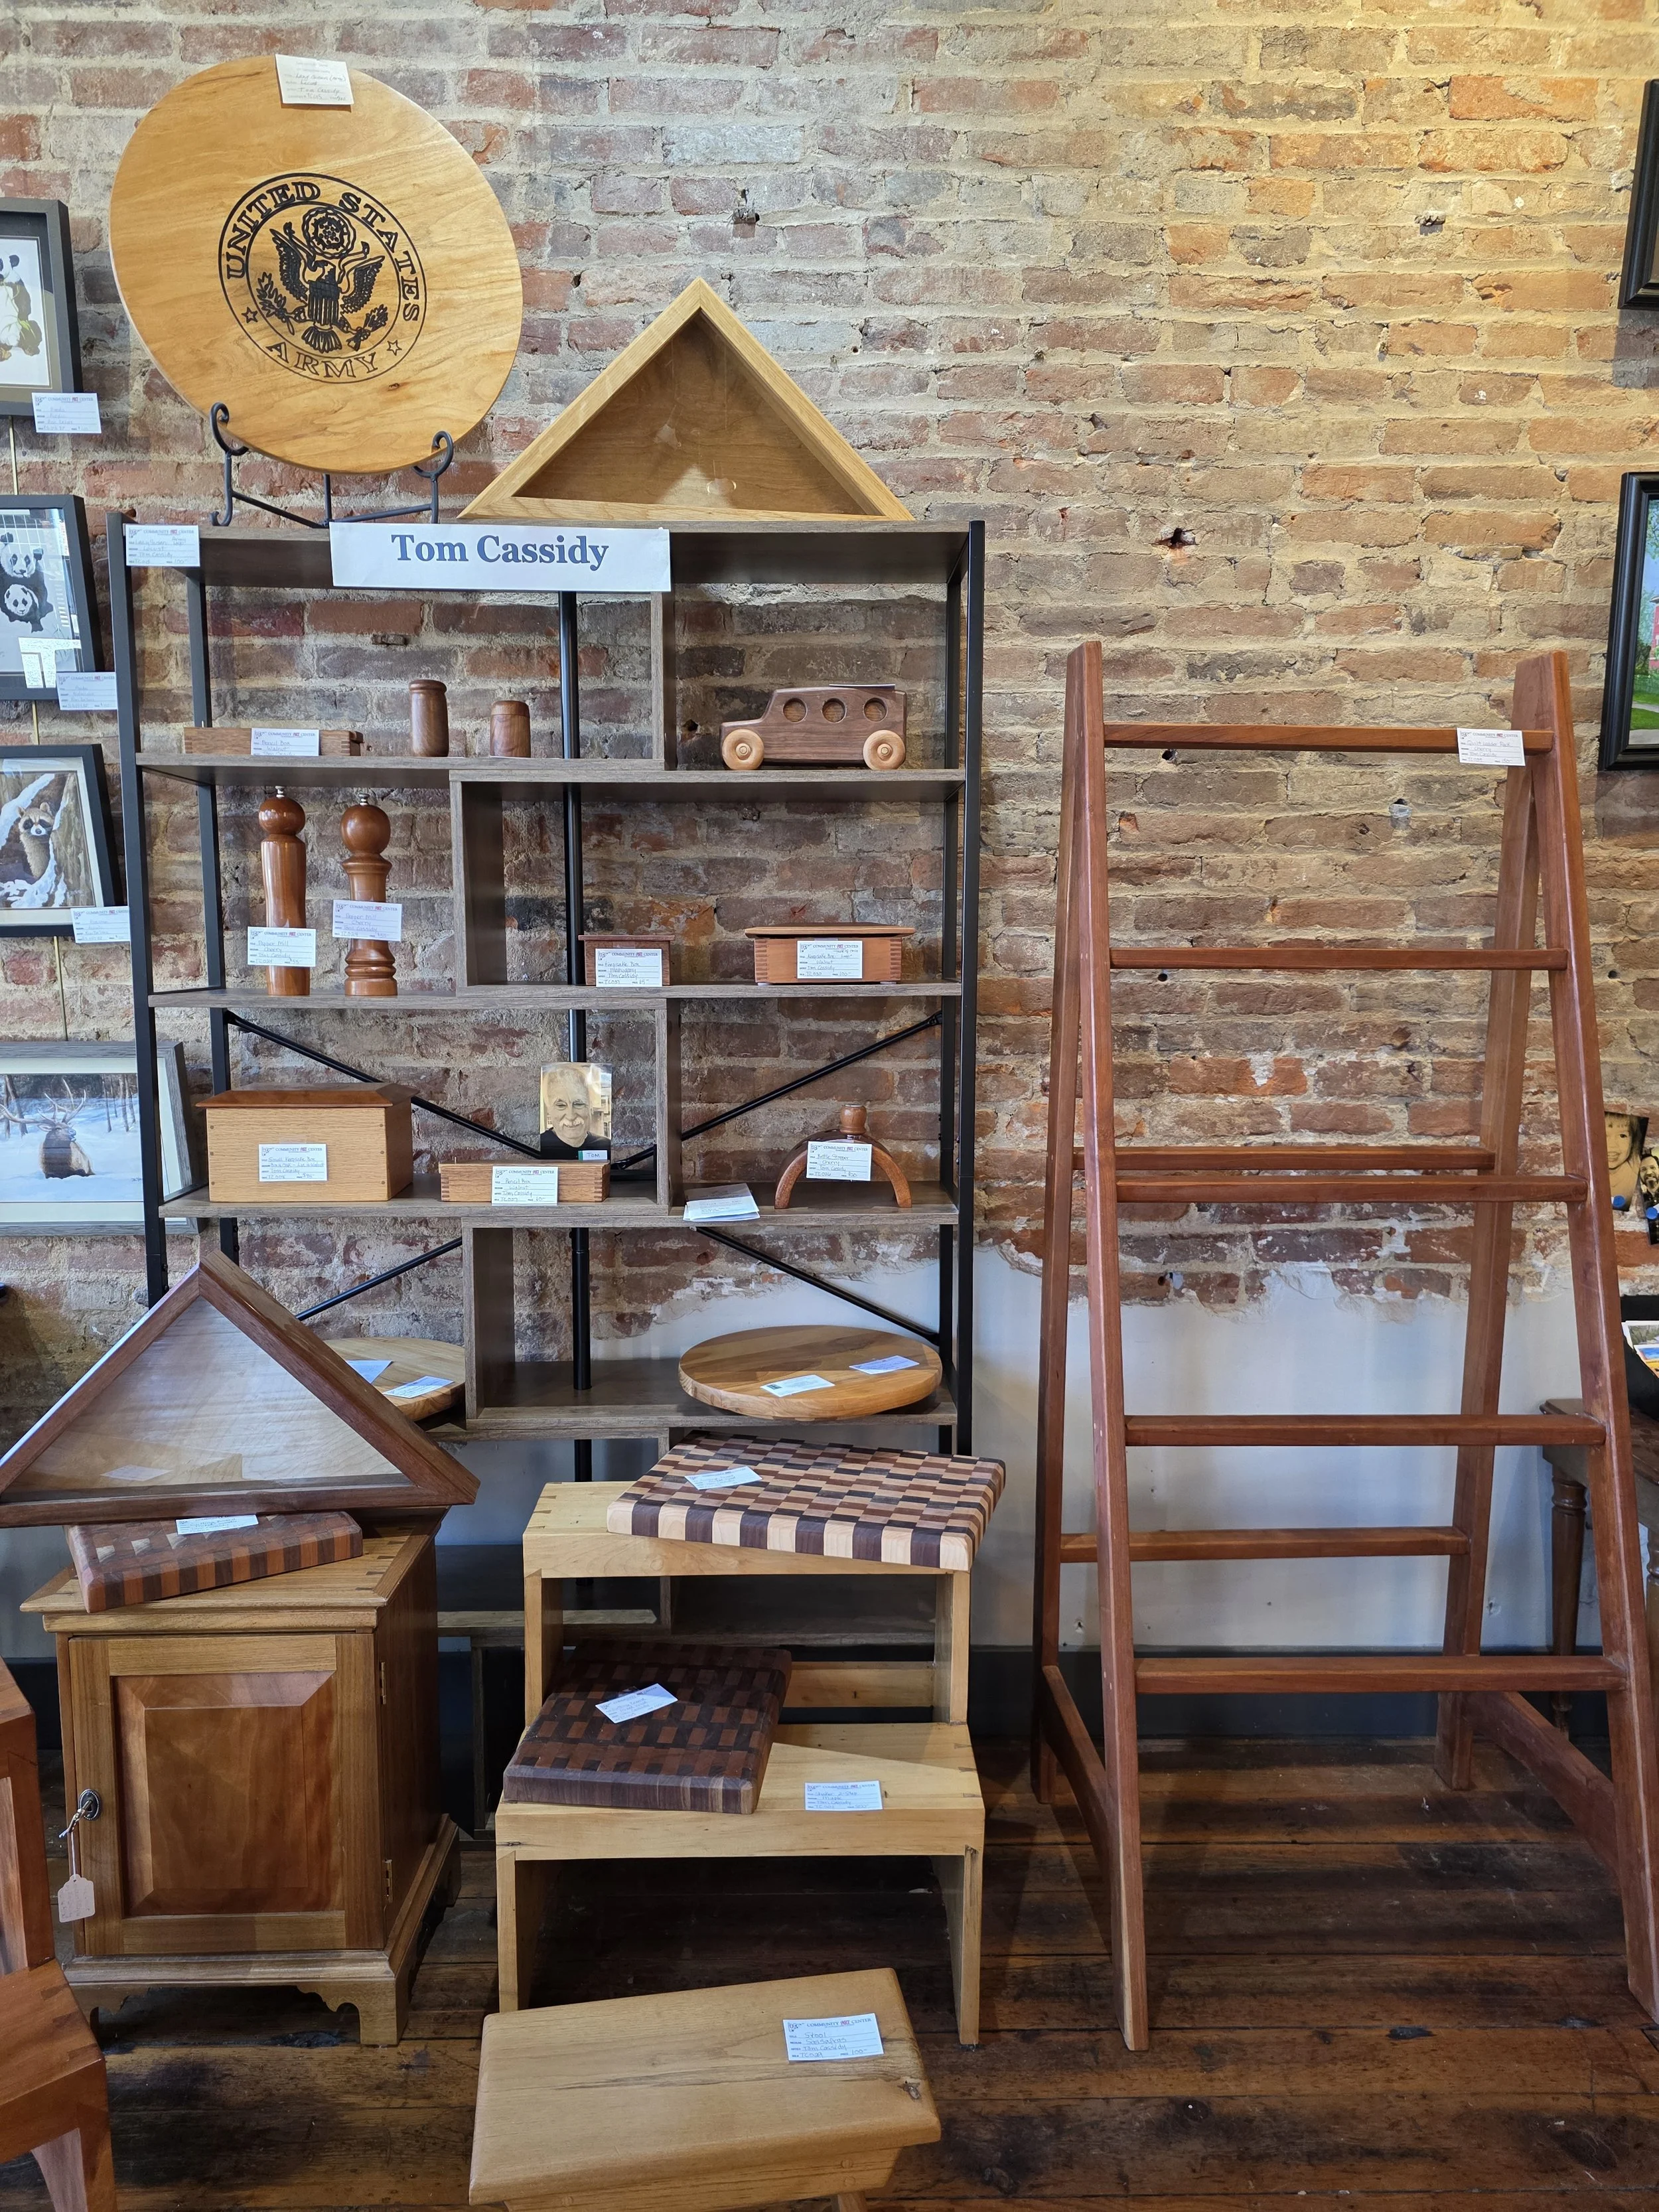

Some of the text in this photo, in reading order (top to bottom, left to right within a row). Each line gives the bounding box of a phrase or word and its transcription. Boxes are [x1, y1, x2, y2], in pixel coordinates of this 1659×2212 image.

[226, 181, 420, 322] UNITED STATES
[266, 341, 378, 378] ARMY
[392, 534, 610, 571] Tom Cassidy
